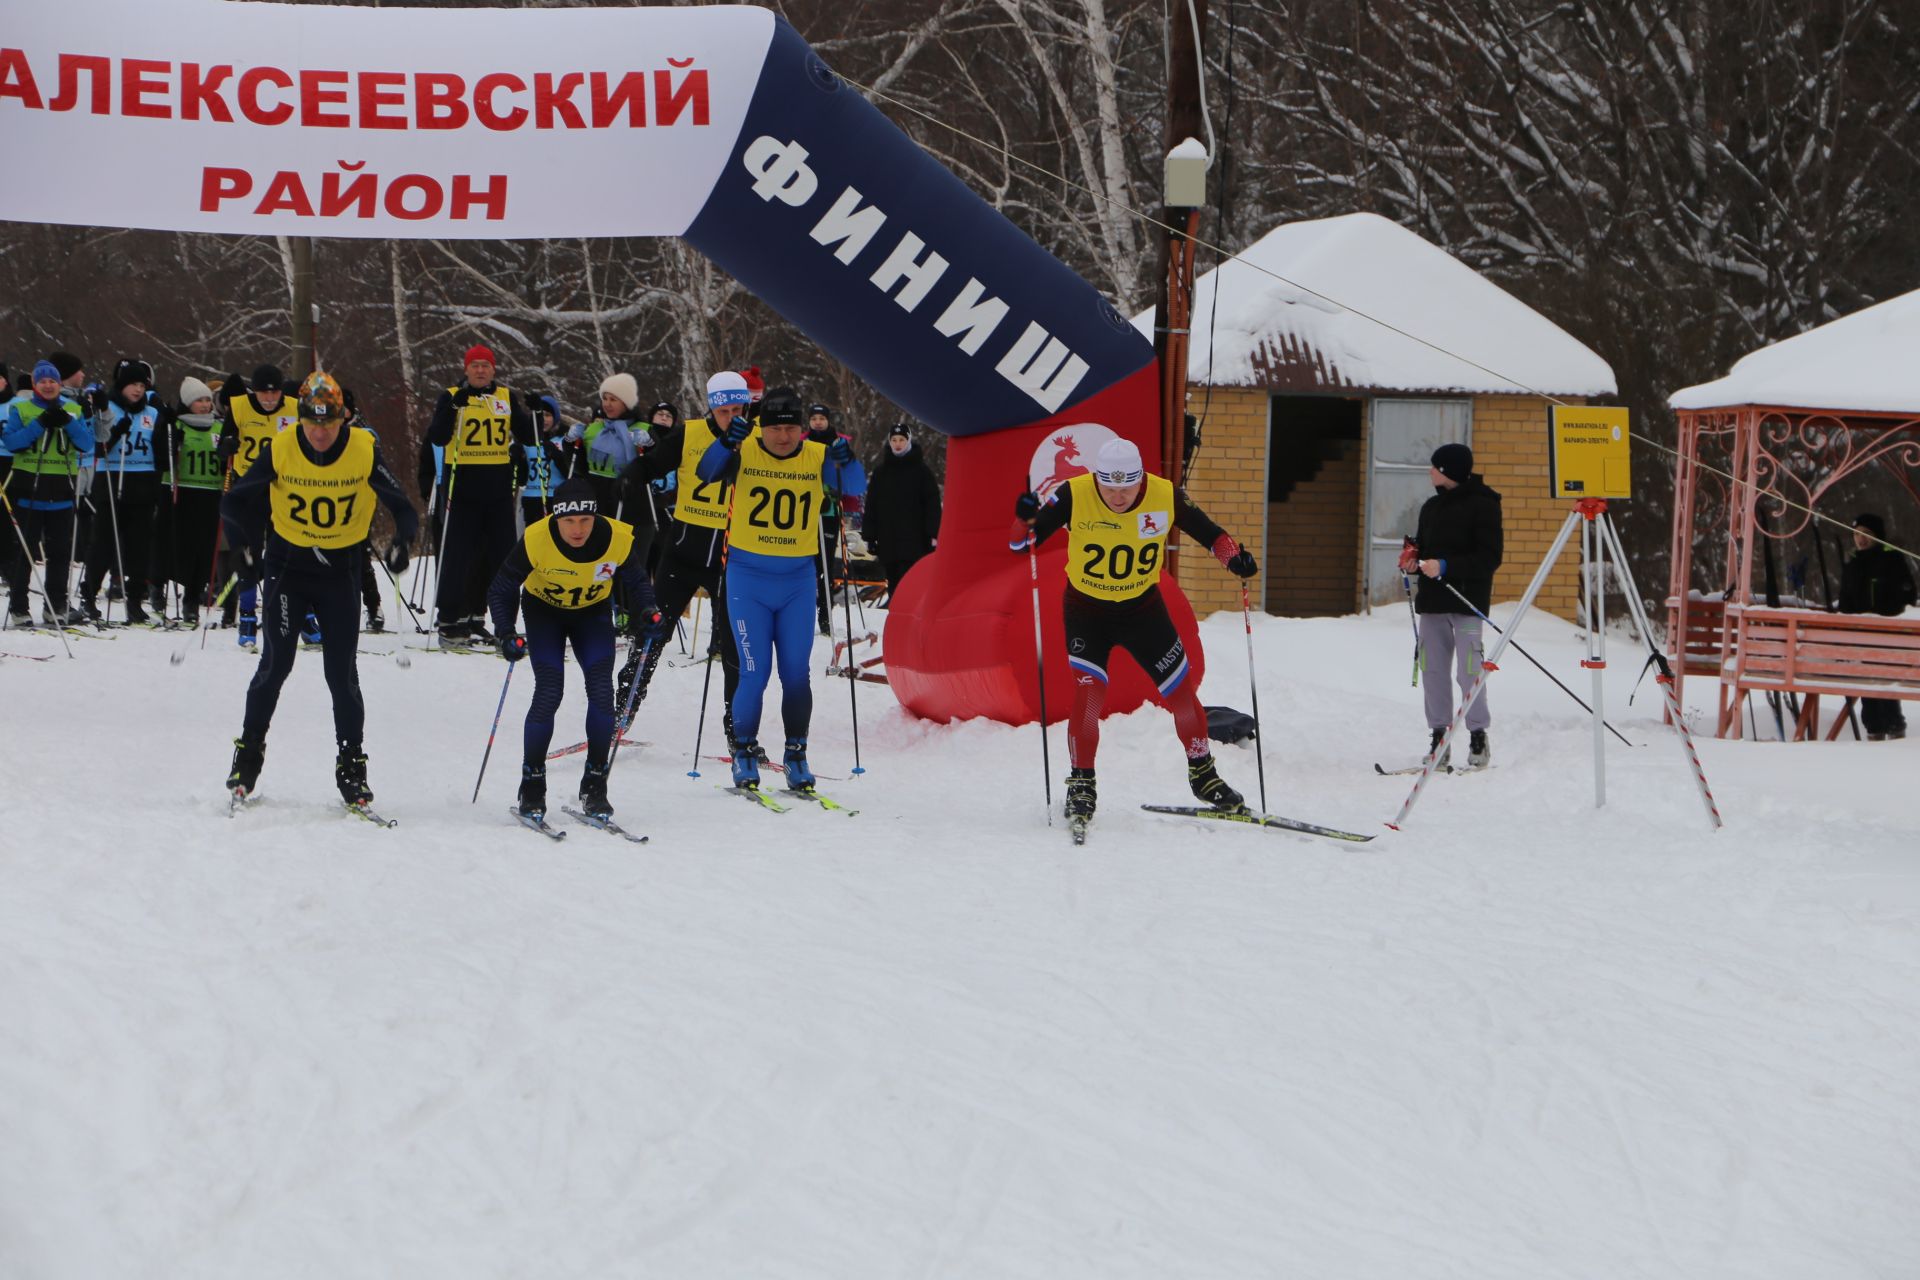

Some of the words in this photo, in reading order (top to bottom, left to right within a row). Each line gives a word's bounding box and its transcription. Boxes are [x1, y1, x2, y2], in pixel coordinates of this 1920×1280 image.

[0, 48, 710, 131] АЛЕКСЕЕВСКИЙ
[200, 159, 508, 220] РАЙОН
[743, 135, 1091, 415] ФИНИШ
[465, 417, 506, 446] 213
[186, 449, 219, 477] 115
[743, 467, 798, 481] АЛЕКСЕЕВСКИЙ
[797, 471, 818, 481] РАЙОН
[287, 492, 358, 528] 207
[552, 501, 596, 514] CRAFT
[683, 505, 728, 519] АЛЕКСЕЕВСКИ
[748, 486, 811, 530] 201
[758, 534, 798, 546] МОСТОВИК
[1083, 542, 1160, 580] 209
[280, 594, 289, 629] CRAFT
[736, 619, 756, 672] SPINE
[1154, 638, 1184, 673] MASTE
[1197, 811, 1252, 824] FISCHER
